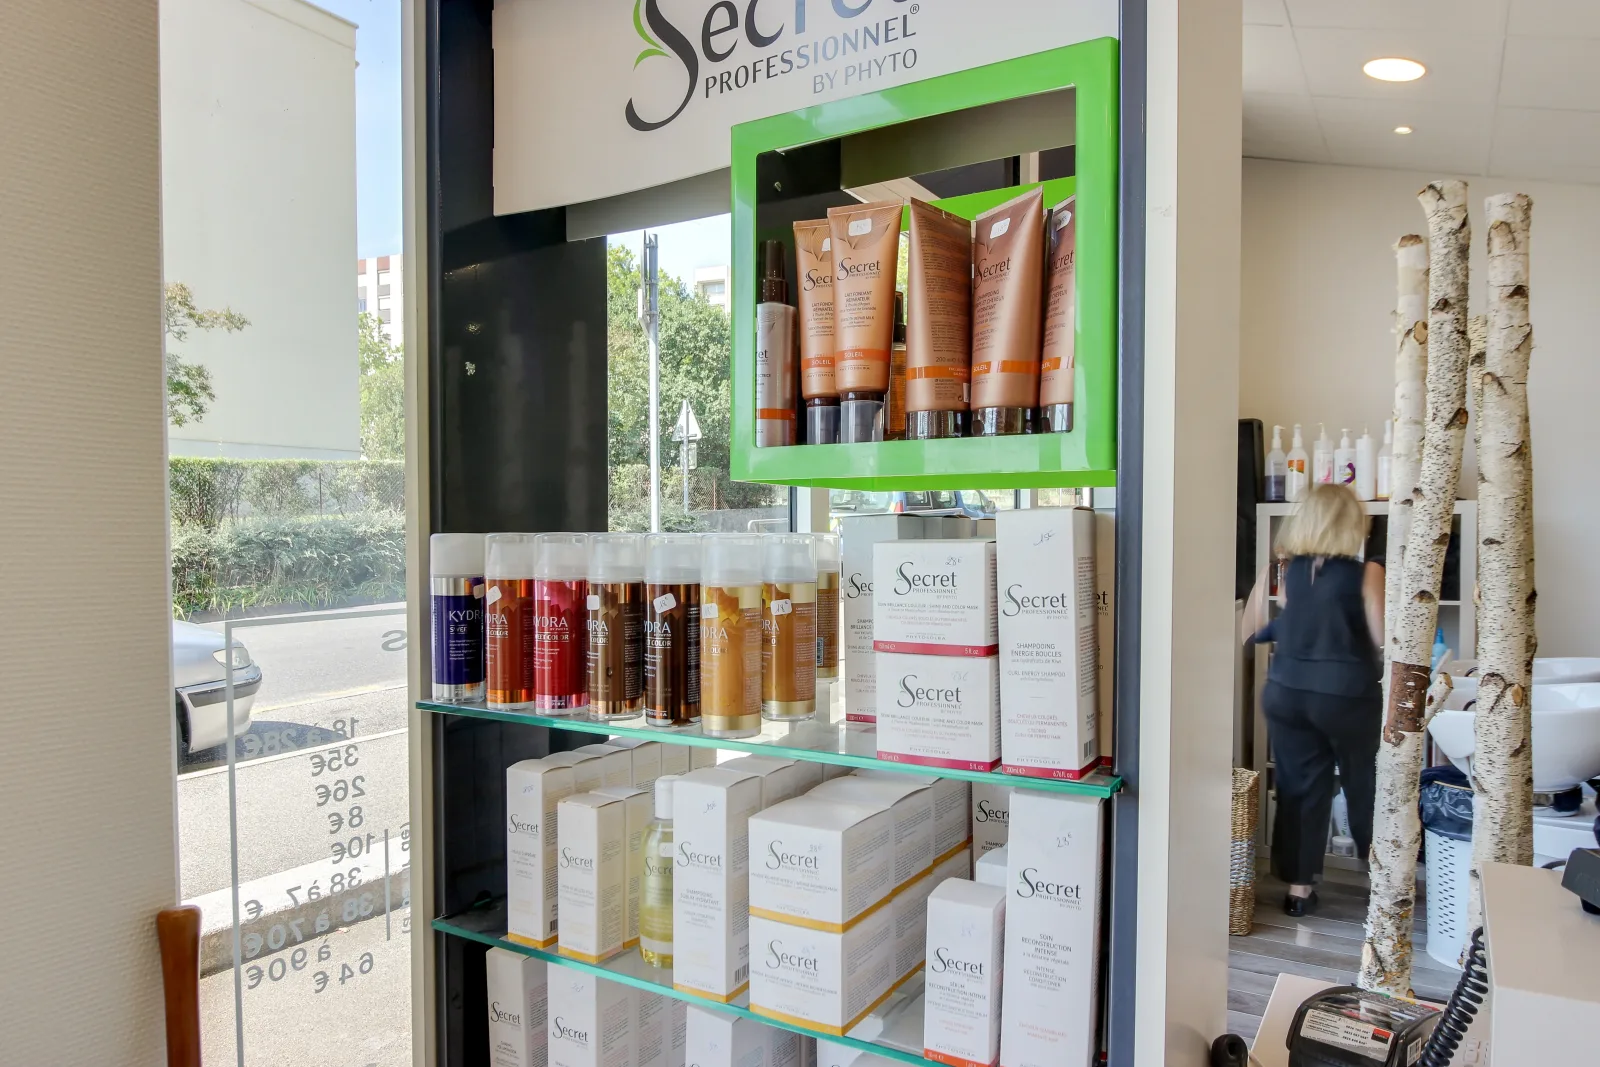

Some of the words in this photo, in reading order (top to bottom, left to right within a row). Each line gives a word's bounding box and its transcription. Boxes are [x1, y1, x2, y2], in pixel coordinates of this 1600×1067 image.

[625, 0, 905, 131] Secr
[705, 15, 917, 99] PROFESSIONNEL
[812, 70, 839, 95] BY
[844, 48, 918, 87] PHYTO
[837, 257, 881, 281] Secret
[974, 257, 1011, 290] Secret
[894, 561, 957, 595] Secret
[1003, 584, 1067, 617] Secret
[1035, 650, 1062, 658] BOUCLES
[897, 674, 961, 708] Secret
[508, 813, 539, 834] Secret
[560, 846, 594, 869] Secret
[676, 841, 723, 867] Secret
[766, 840, 819, 870] Secret
[1016, 867, 1081, 899] Secret
[766, 939, 819, 971] Secret
[931, 947, 984, 975] Secret
[490, 1001, 521, 1024] Secret
[552, 1016, 589, 1043] Secret
